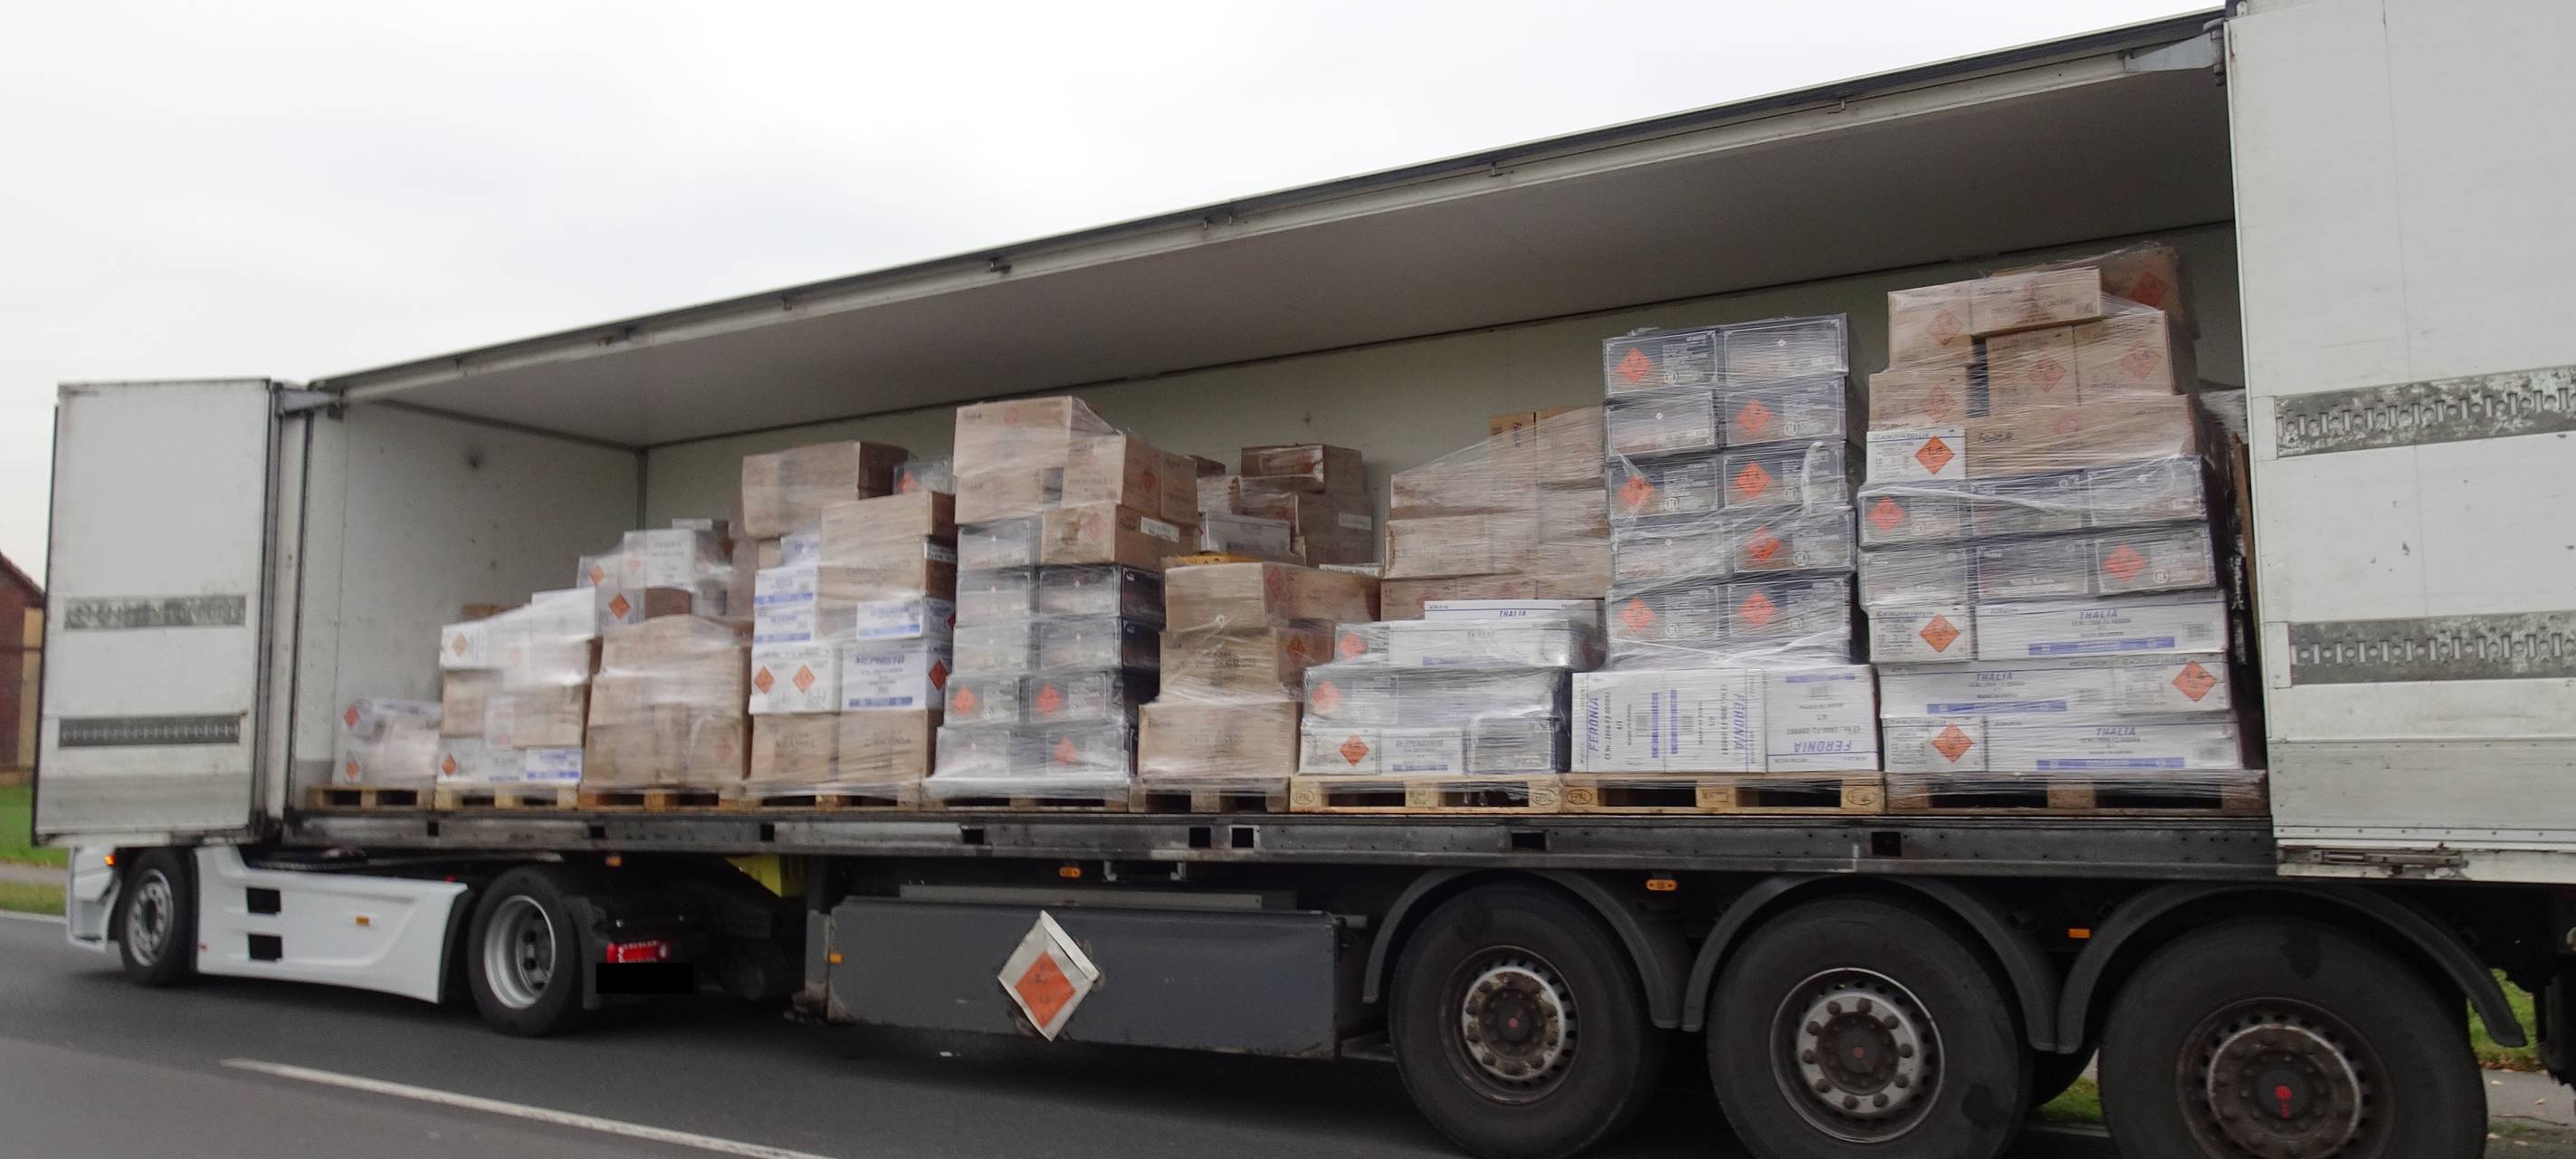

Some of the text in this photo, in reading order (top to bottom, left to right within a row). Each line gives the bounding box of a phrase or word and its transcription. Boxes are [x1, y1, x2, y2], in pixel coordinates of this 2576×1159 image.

[1499, 609, 1527, 618] THALIA
[2078, 608, 2118, 619] THALIA
[1976, 672, 2013, 682] THALIA
[1587, 697, 1599, 752] FERONIA
[1733, 694, 1746, 751] FERONIA
[2096, 727, 2137, 736] THALIA
[1793, 740, 1853, 752] FERONIA
